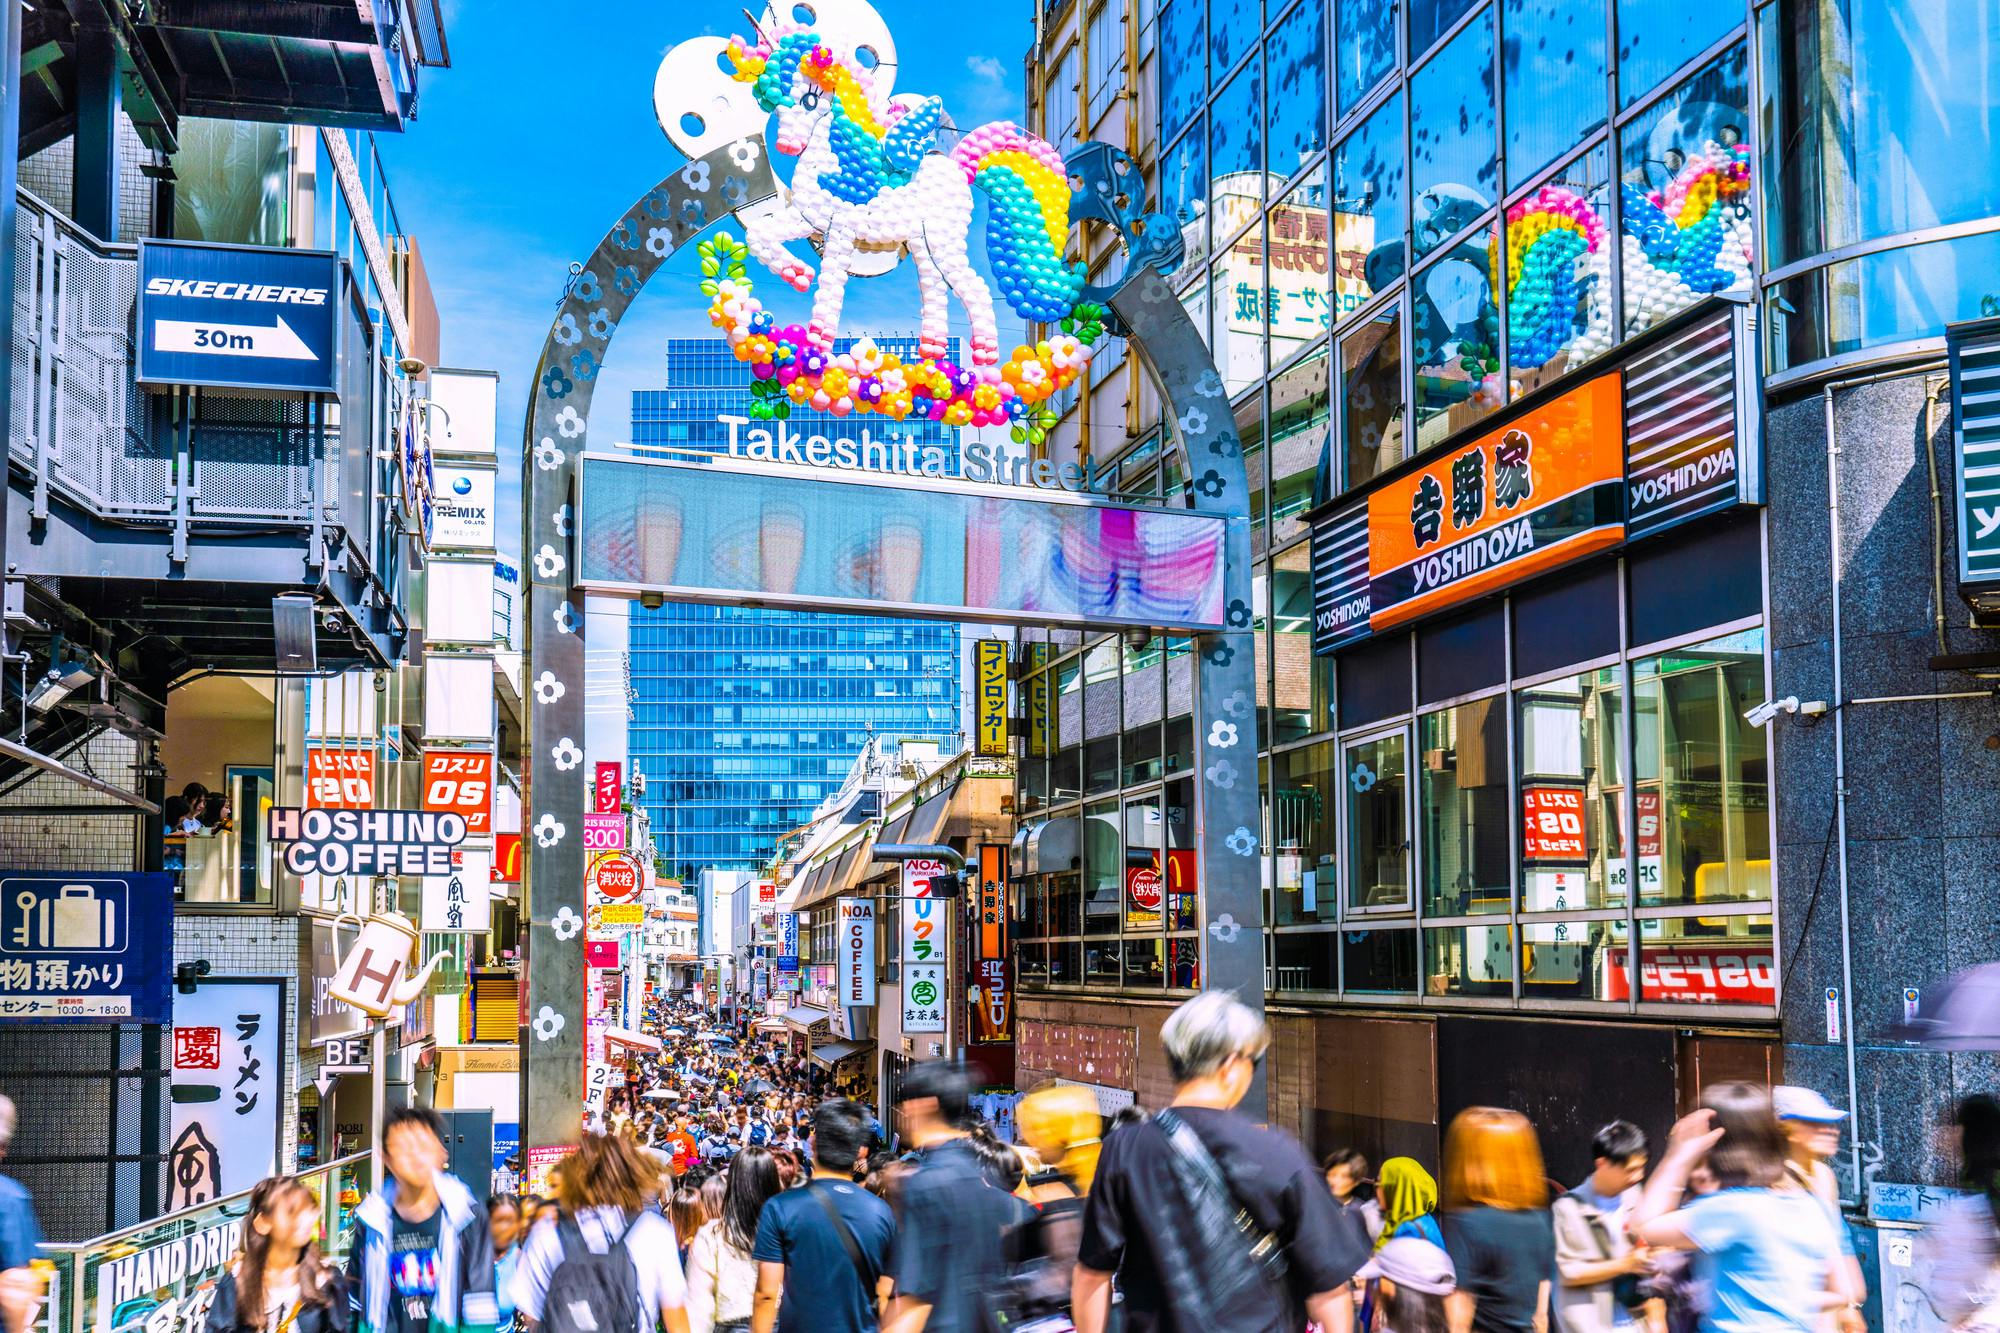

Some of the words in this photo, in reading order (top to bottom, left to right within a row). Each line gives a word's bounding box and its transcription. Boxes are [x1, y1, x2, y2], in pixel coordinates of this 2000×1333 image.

[145, 278, 328, 305] SKECHERS
[194, 328, 254, 350] 30m
[717, 414, 948, 480] Takeshita
[964, 442, 1103, 494] Street
[1410, 428, 1533, 549] 吉野家
[1630, 446, 1735, 511] YOSHINOYA
[1412, 518, 1535, 595] YOSHINOYA
[1316, 595, 1371, 632] YOSHINOYA
[983, 642, 1005, 742] コインロッカー
[429, 758, 486, 775] クスリ
[427, 780, 487, 806] OS
[601, 769, 617, 814] ダイソ
[270, 809, 467, 845] HOSHINO
[584, 828, 620, 848] 300
[287, 841, 451, 874] COFFEE
[906, 859, 943, 871] NOA
[600, 871, 633, 887] 消火栓
[842, 905, 873, 918] NOA
[850, 924, 864, 1001] COFFEE
[934, 951, 943, 959] B1
[347, 947, 402, 1005] H
[0, 1000, 53, 1013] センター
[57, 1006, 84, 1015] 10:00
[99, 1006, 126, 1015] 18:00
[234, 1013, 262, 1116] ラーメン
[325, 1040, 361, 1065] BF
[166, 1084, 222, 1213] 一風
[113, 1241, 187, 1306] HAND
[189, 1221, 242, 1276] DRIP
